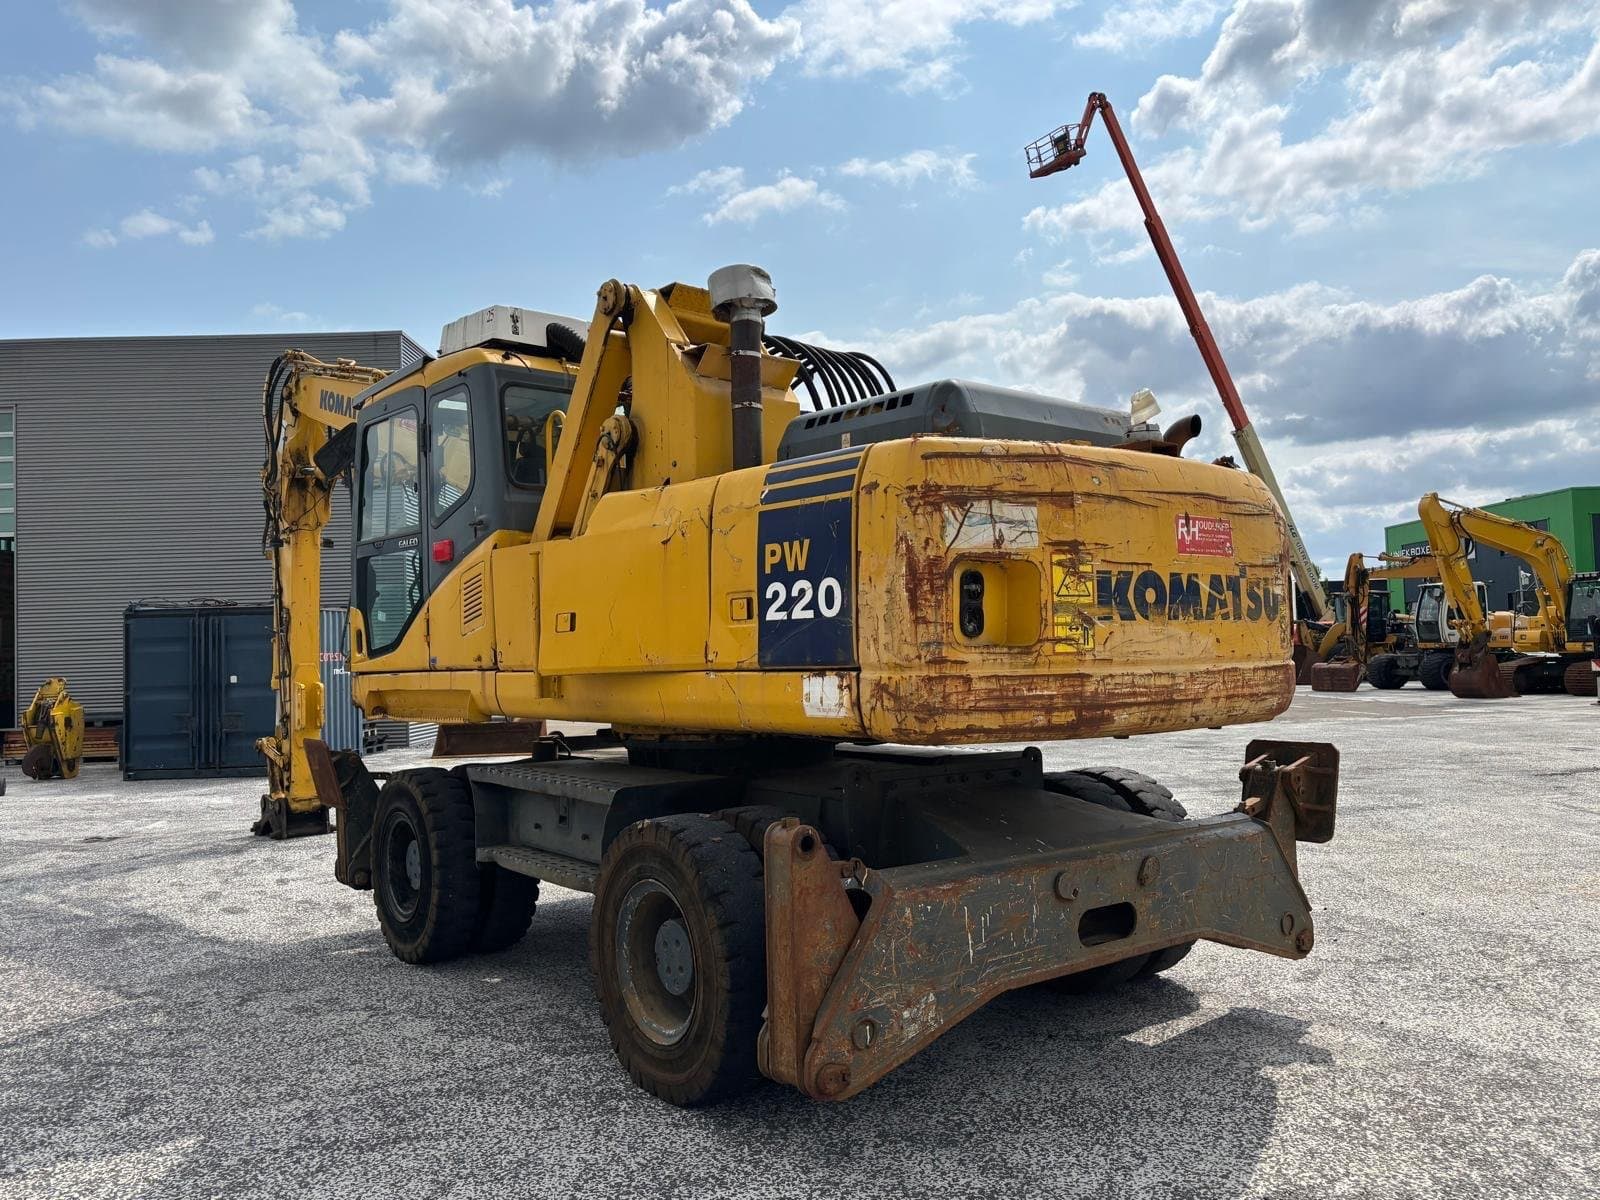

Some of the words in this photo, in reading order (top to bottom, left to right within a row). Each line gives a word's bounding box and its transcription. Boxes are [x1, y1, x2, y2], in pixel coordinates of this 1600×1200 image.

[765, 539, 810, 575] PW
[765, 577, 842, 621] 220
[1096, 567, 1280, 621] KOMATSU
